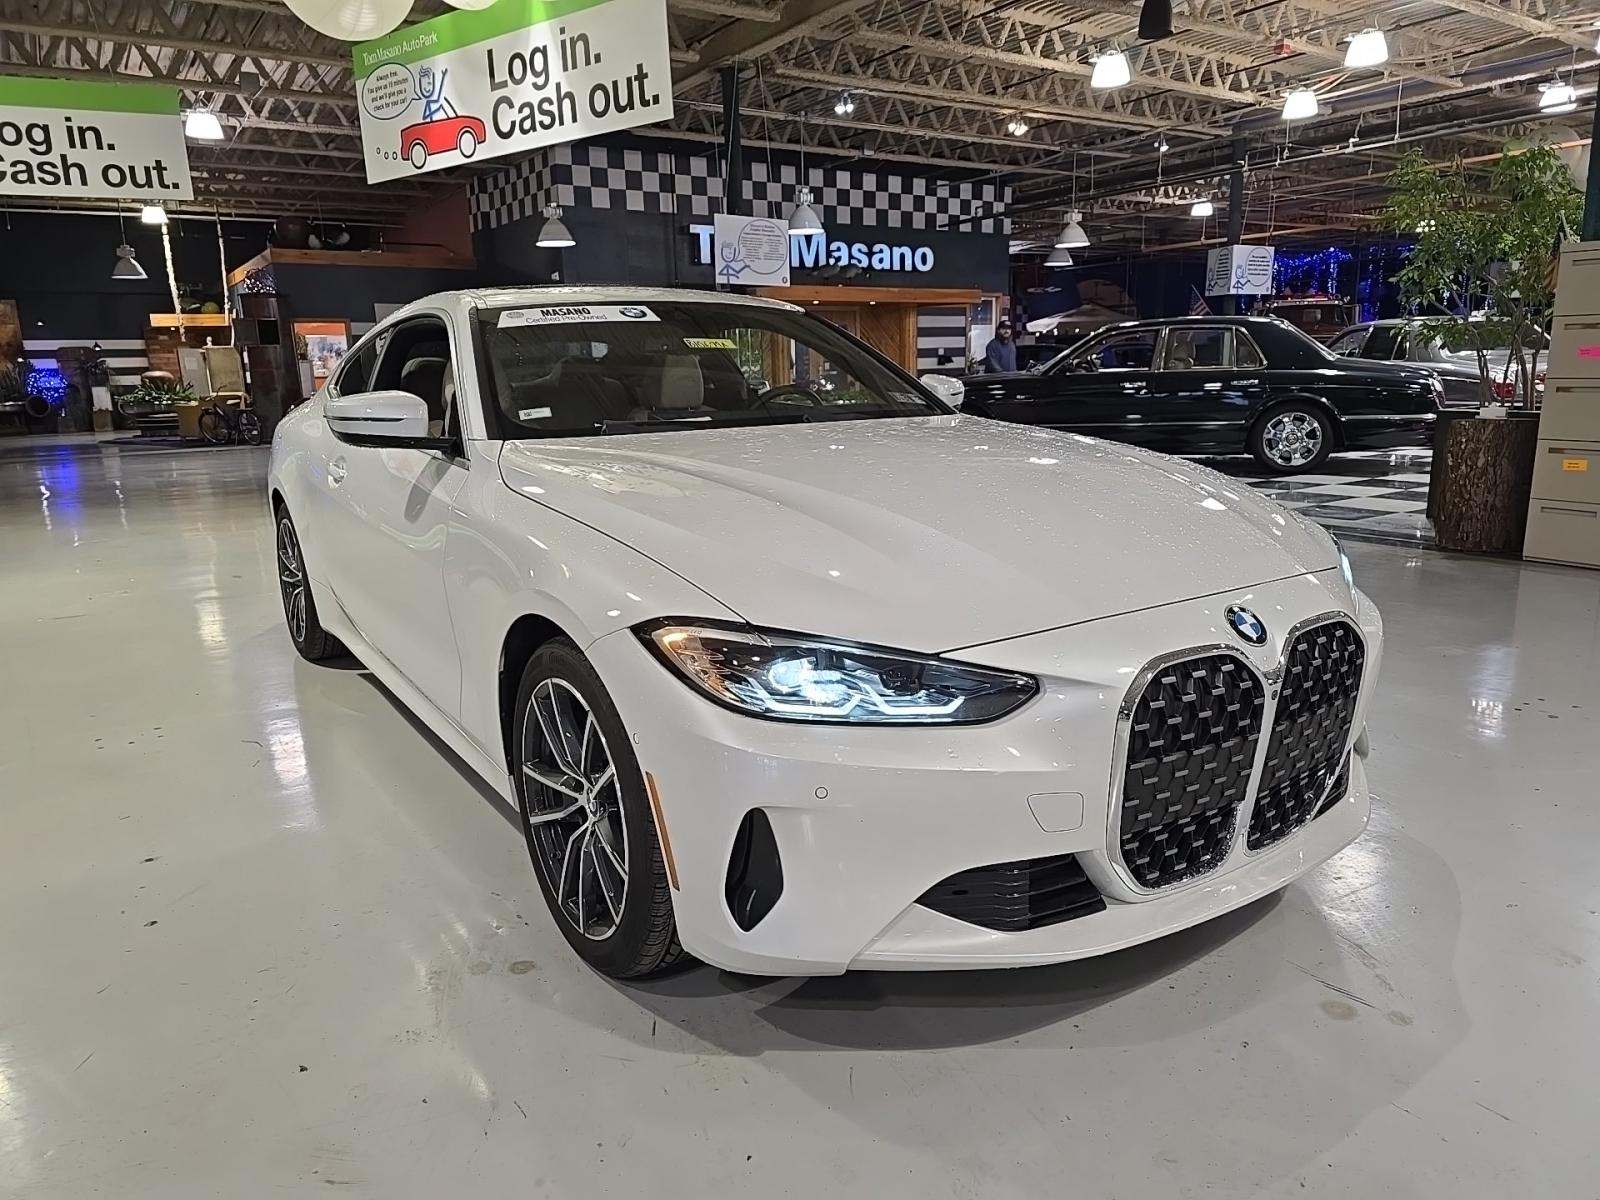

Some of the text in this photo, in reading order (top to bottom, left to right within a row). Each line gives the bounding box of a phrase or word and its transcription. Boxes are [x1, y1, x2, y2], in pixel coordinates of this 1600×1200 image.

[363, 52, 377, 65] Tom
[402, 31, 438, 54] AutoPark
[487, 26, 602, 91] Log in.
[492, 63, 660, 140] Cash out.
[0, 116, 116, 156] og in.
[101, 159, 180, 190] out.
[788, 232, 935, 272] Masano
[526, 315, 560, 324] Certified
[540, 307, 591, 317] MASANO
